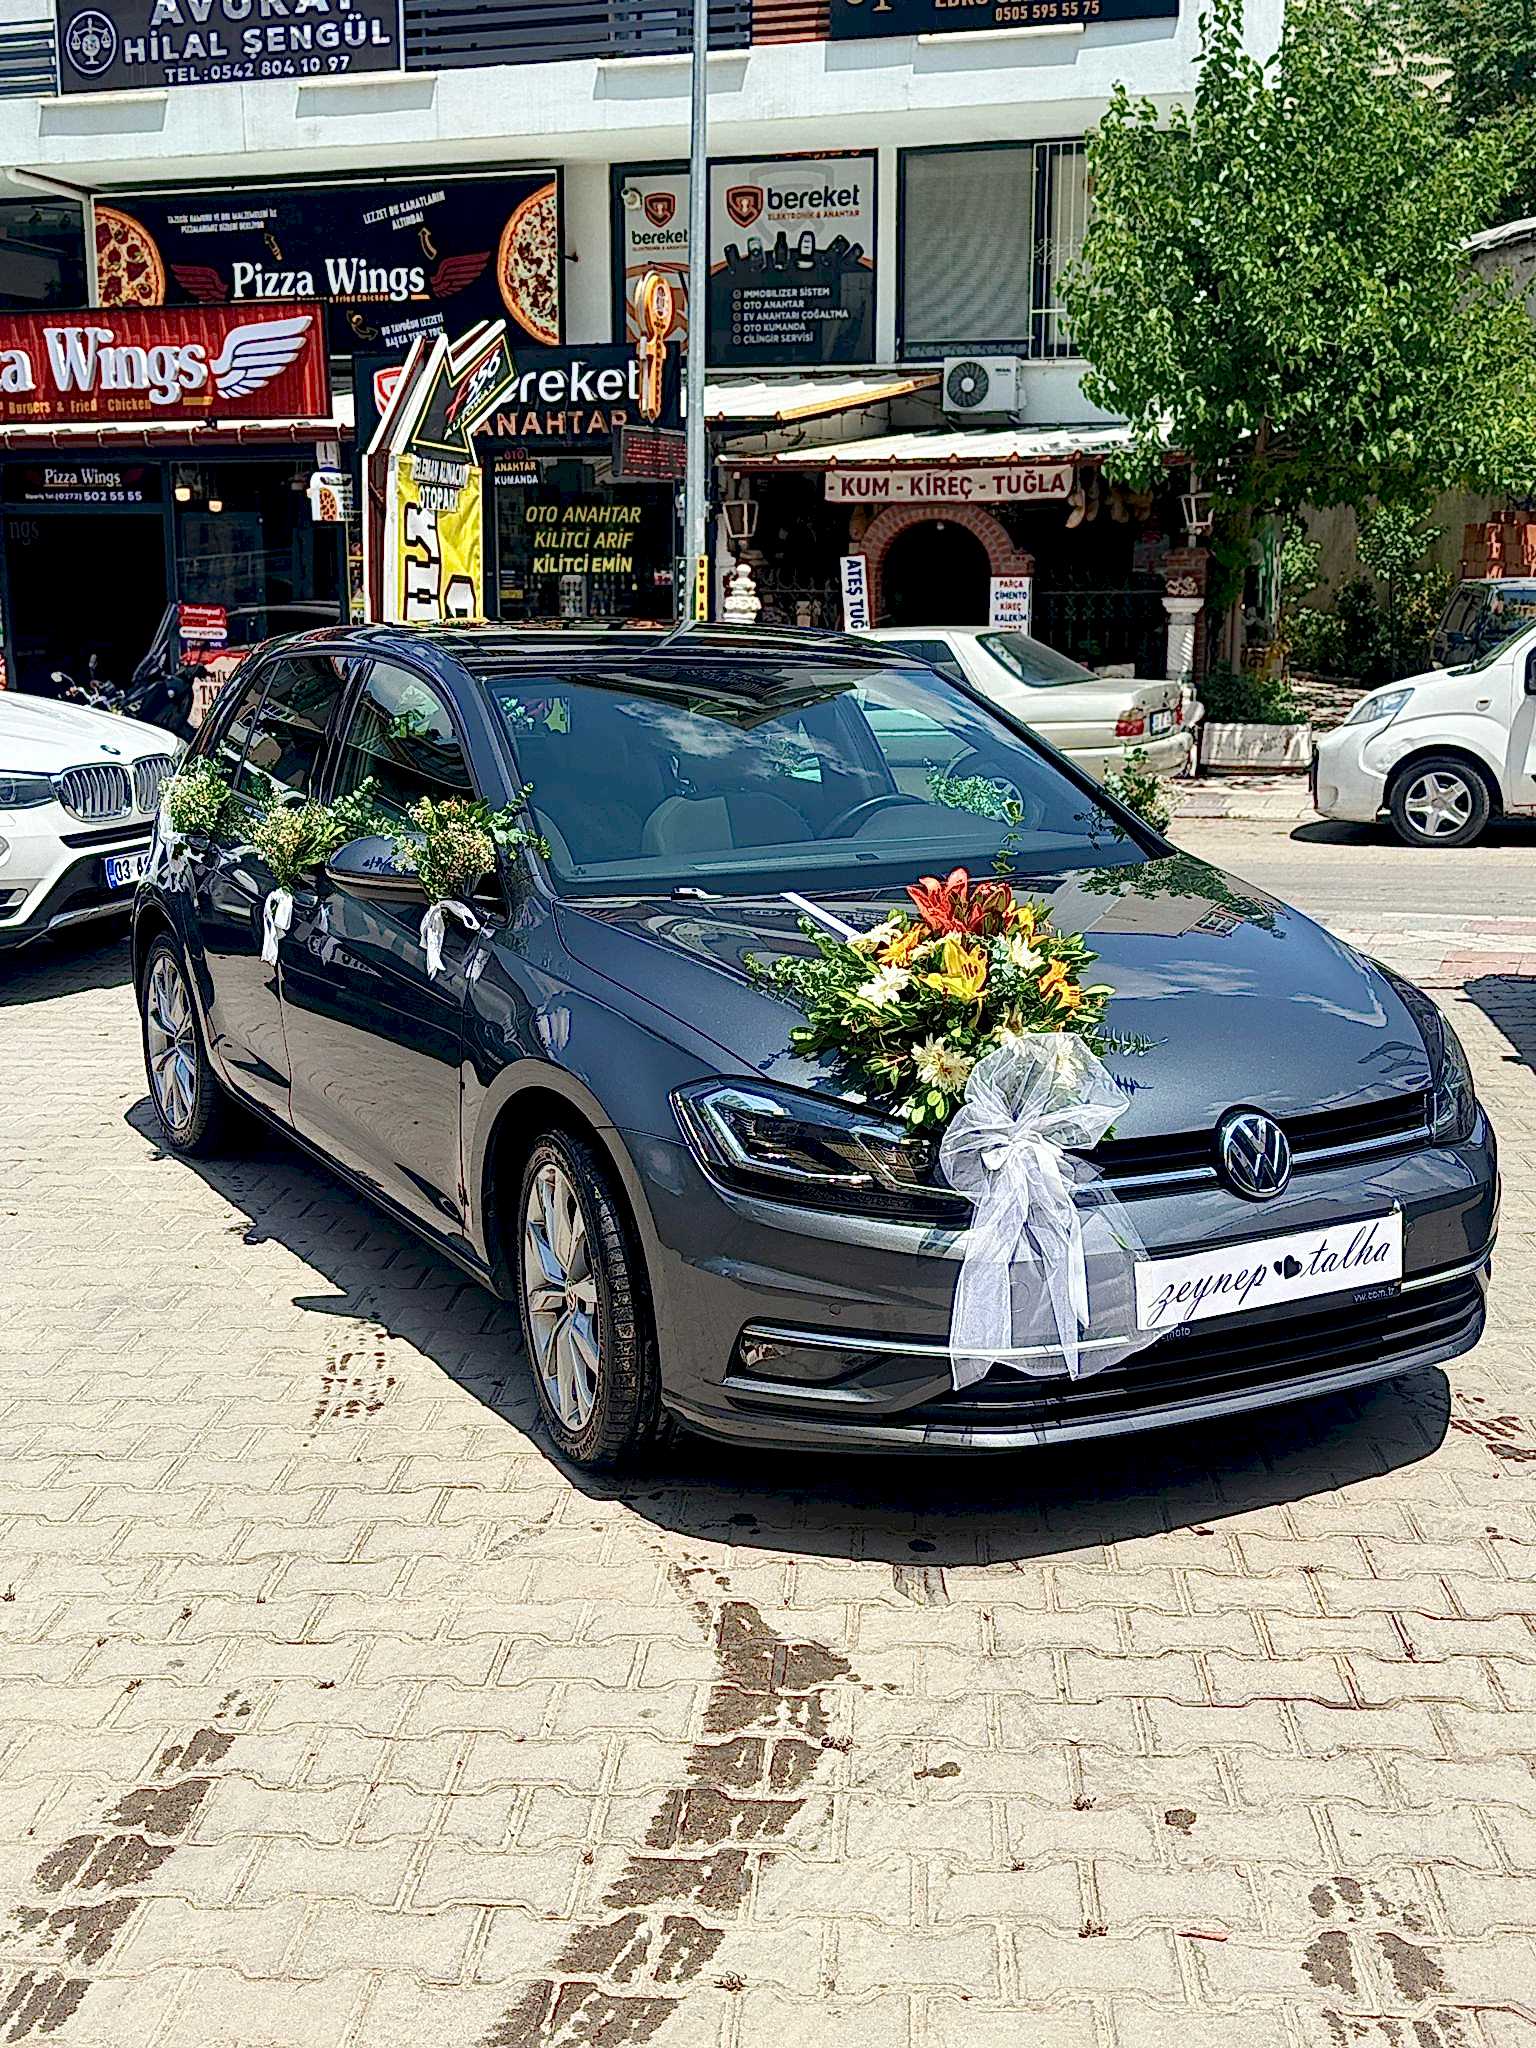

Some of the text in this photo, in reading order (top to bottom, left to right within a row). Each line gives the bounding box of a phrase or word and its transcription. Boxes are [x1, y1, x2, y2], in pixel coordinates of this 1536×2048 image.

[995, 1, 1099, 21] 0505 595 55 75
[123, 14, 391, 63] HİLAL ŞENGÜL
[260, 59, 295, 77] 804
[299, 57, 321, 74] 10
[327, 55, 350, 71] 97
[767, 184, 860, 210] bereket
[632, 229, 688, 245] bereket
[231, 257, 425, 301] Pizza Wings
[743, 299, 804, 310] OTO ANAHTAR
[743, 312, 755, 321] EV
[801, 309, 849, 321] ÇOĞALTMA
[743, 322, 806, 332] OTO KUMANDA
[43, 327, 208, 404] Wings
[517, 361, 642, 402] reket
[9, 400, 51, 414] Burgers
[70, 398, 98, 412] Fried
[107, 397, 152, 412] Chicken
[494, 461, 536, 472] ANAHTAR
[45, 468, 121, 487] Pizza Wings
[494, 474, 538, 486] KUMANDA
[841, 477, 890, 496] KUM
[910, 472, 973, 499] KİREÇ
[992, 470, 1066, 495] TUĞLA
[84, 491, 107, 501] 502
[110, 491, 125, 501] 55
[127, 490, 142, 501] 55
[526, 506, 641, 523] OTO ANAHTAR
[534, 526, 634, 549] KİLİTCİ ARİF
[532, 553, 633, 573] KİLİTCİ EMİN
[1000, 579, 1024, 588] PARÇA
[846, 559, 869, 630] ATEŞ TUĞ
[994, 590, 1028, 600] ÇİMENTO
[1000, 601, 1022, 611] KİREÇ
[115, 859, 131, 881] 03
[1147, 1222, 1390, 1327] zeynep talha
